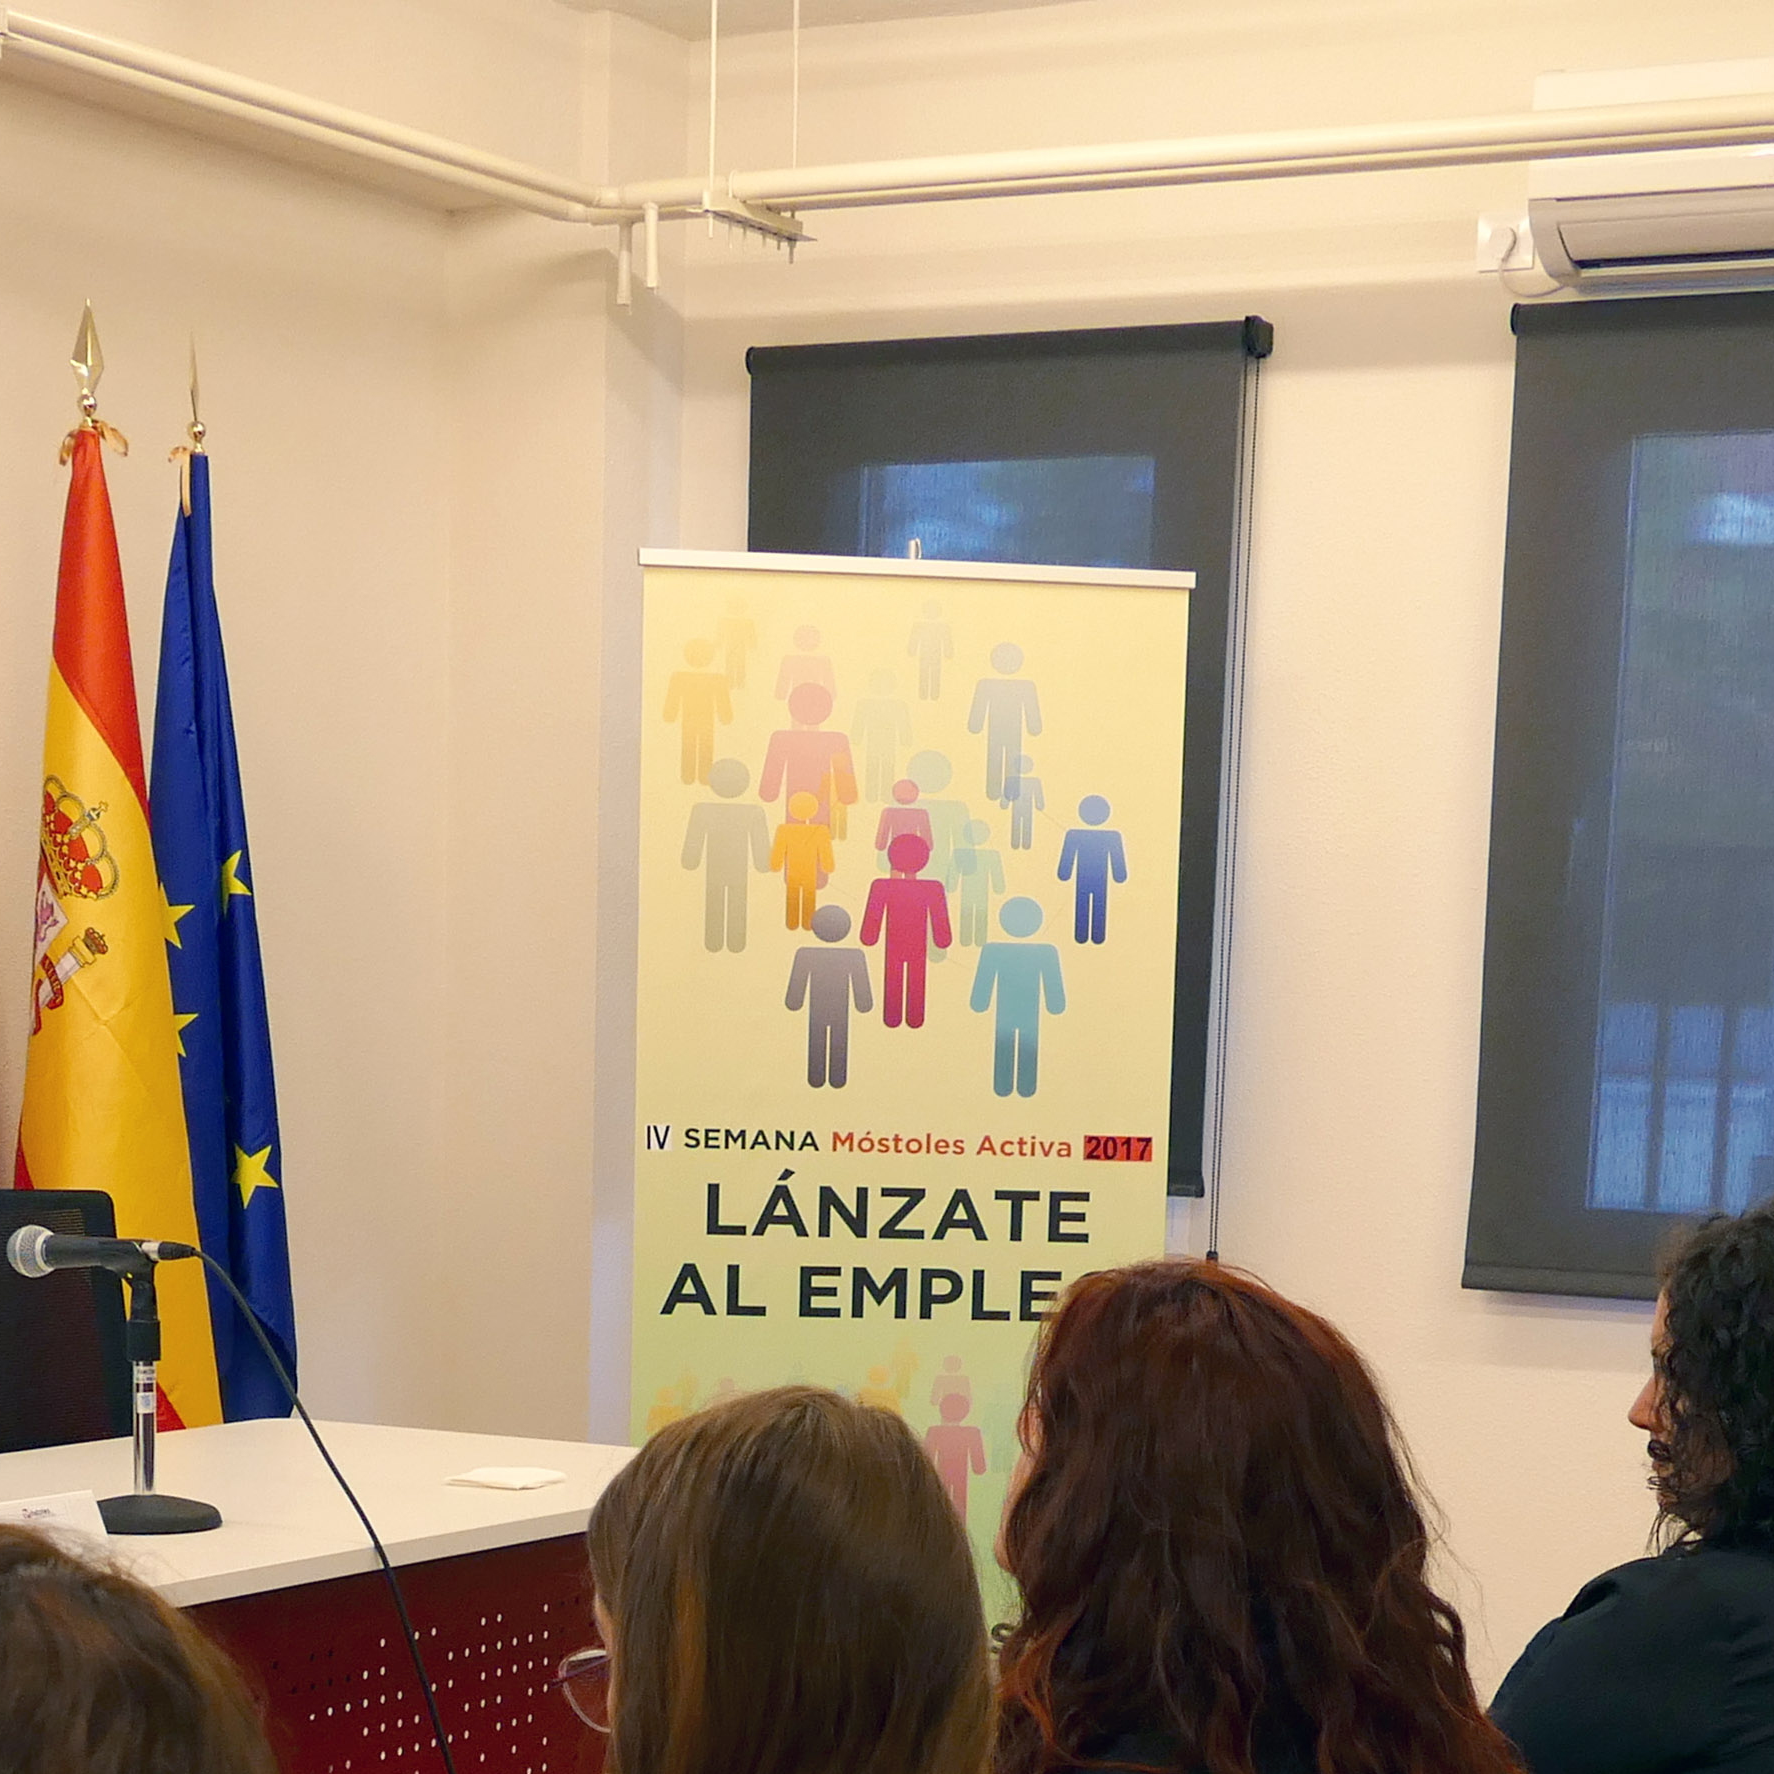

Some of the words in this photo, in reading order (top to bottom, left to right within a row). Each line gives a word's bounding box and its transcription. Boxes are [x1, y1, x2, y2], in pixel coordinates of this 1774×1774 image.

[645, 1124, 671, 1151] IV
[683, 1128, 820, 1153] SEMANA
[831, 1130, 966, 1158] Móstoles
[976, 1135, 1073, 1159] Activa
[1085, 1136, 1153, 1161] 2017
[705, 1168, 1092, 1244] LÁNZATE
[659, 1263, 768, 1318] AL
[798, 1265, 1103, 1323] EMPLE
